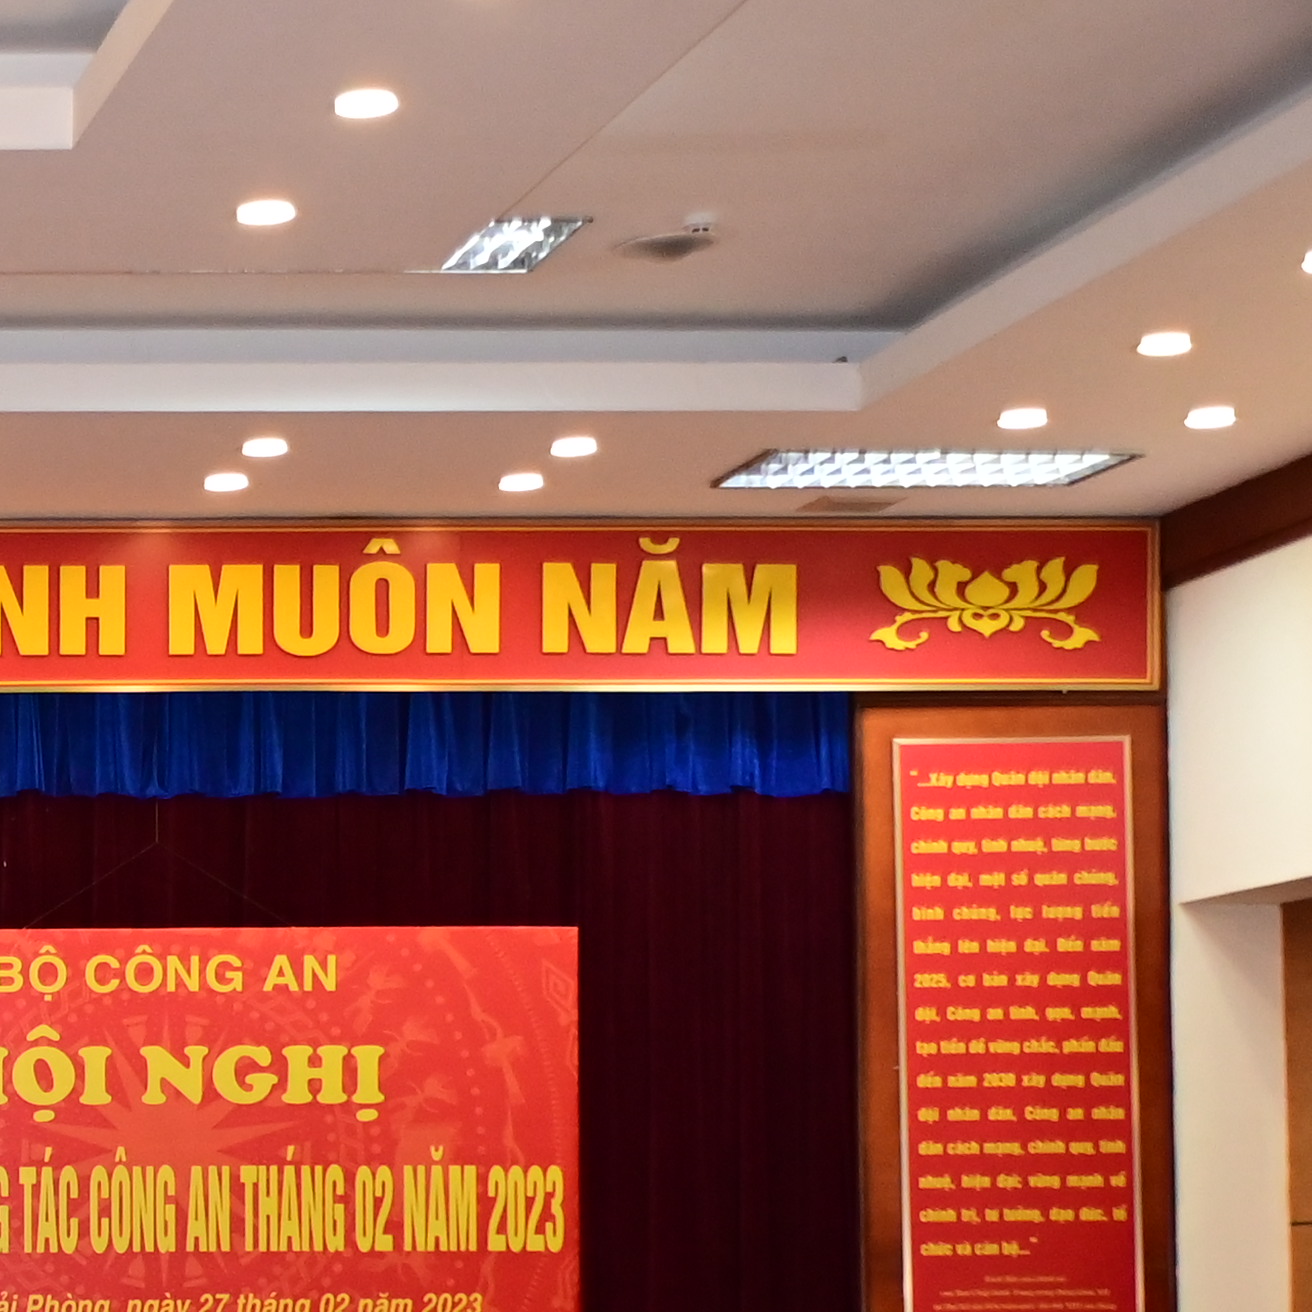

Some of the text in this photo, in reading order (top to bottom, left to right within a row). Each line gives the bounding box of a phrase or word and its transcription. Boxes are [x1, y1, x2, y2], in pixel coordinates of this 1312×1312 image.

[168, 537, 500, 656] MUÔN
[541, 535, 797, 656] NĂM
[85, 945, 243, 994] CÔNG
[263, 954, 337, 992] AN
[140, 1045, 385, 1121] NGHỊ
[19, 1147, 79, 1254] TÁC
[89, 1146, 175, 1254] CÔNG
[186, 1165, 231, 1252] AN
[240, 1146, 345, 1253] THÁNG
[355, 1165, 394, 1253] 02
[403, 1146, 477, 1252] NĂM
[487, 1165, 564, 1253] 2023
